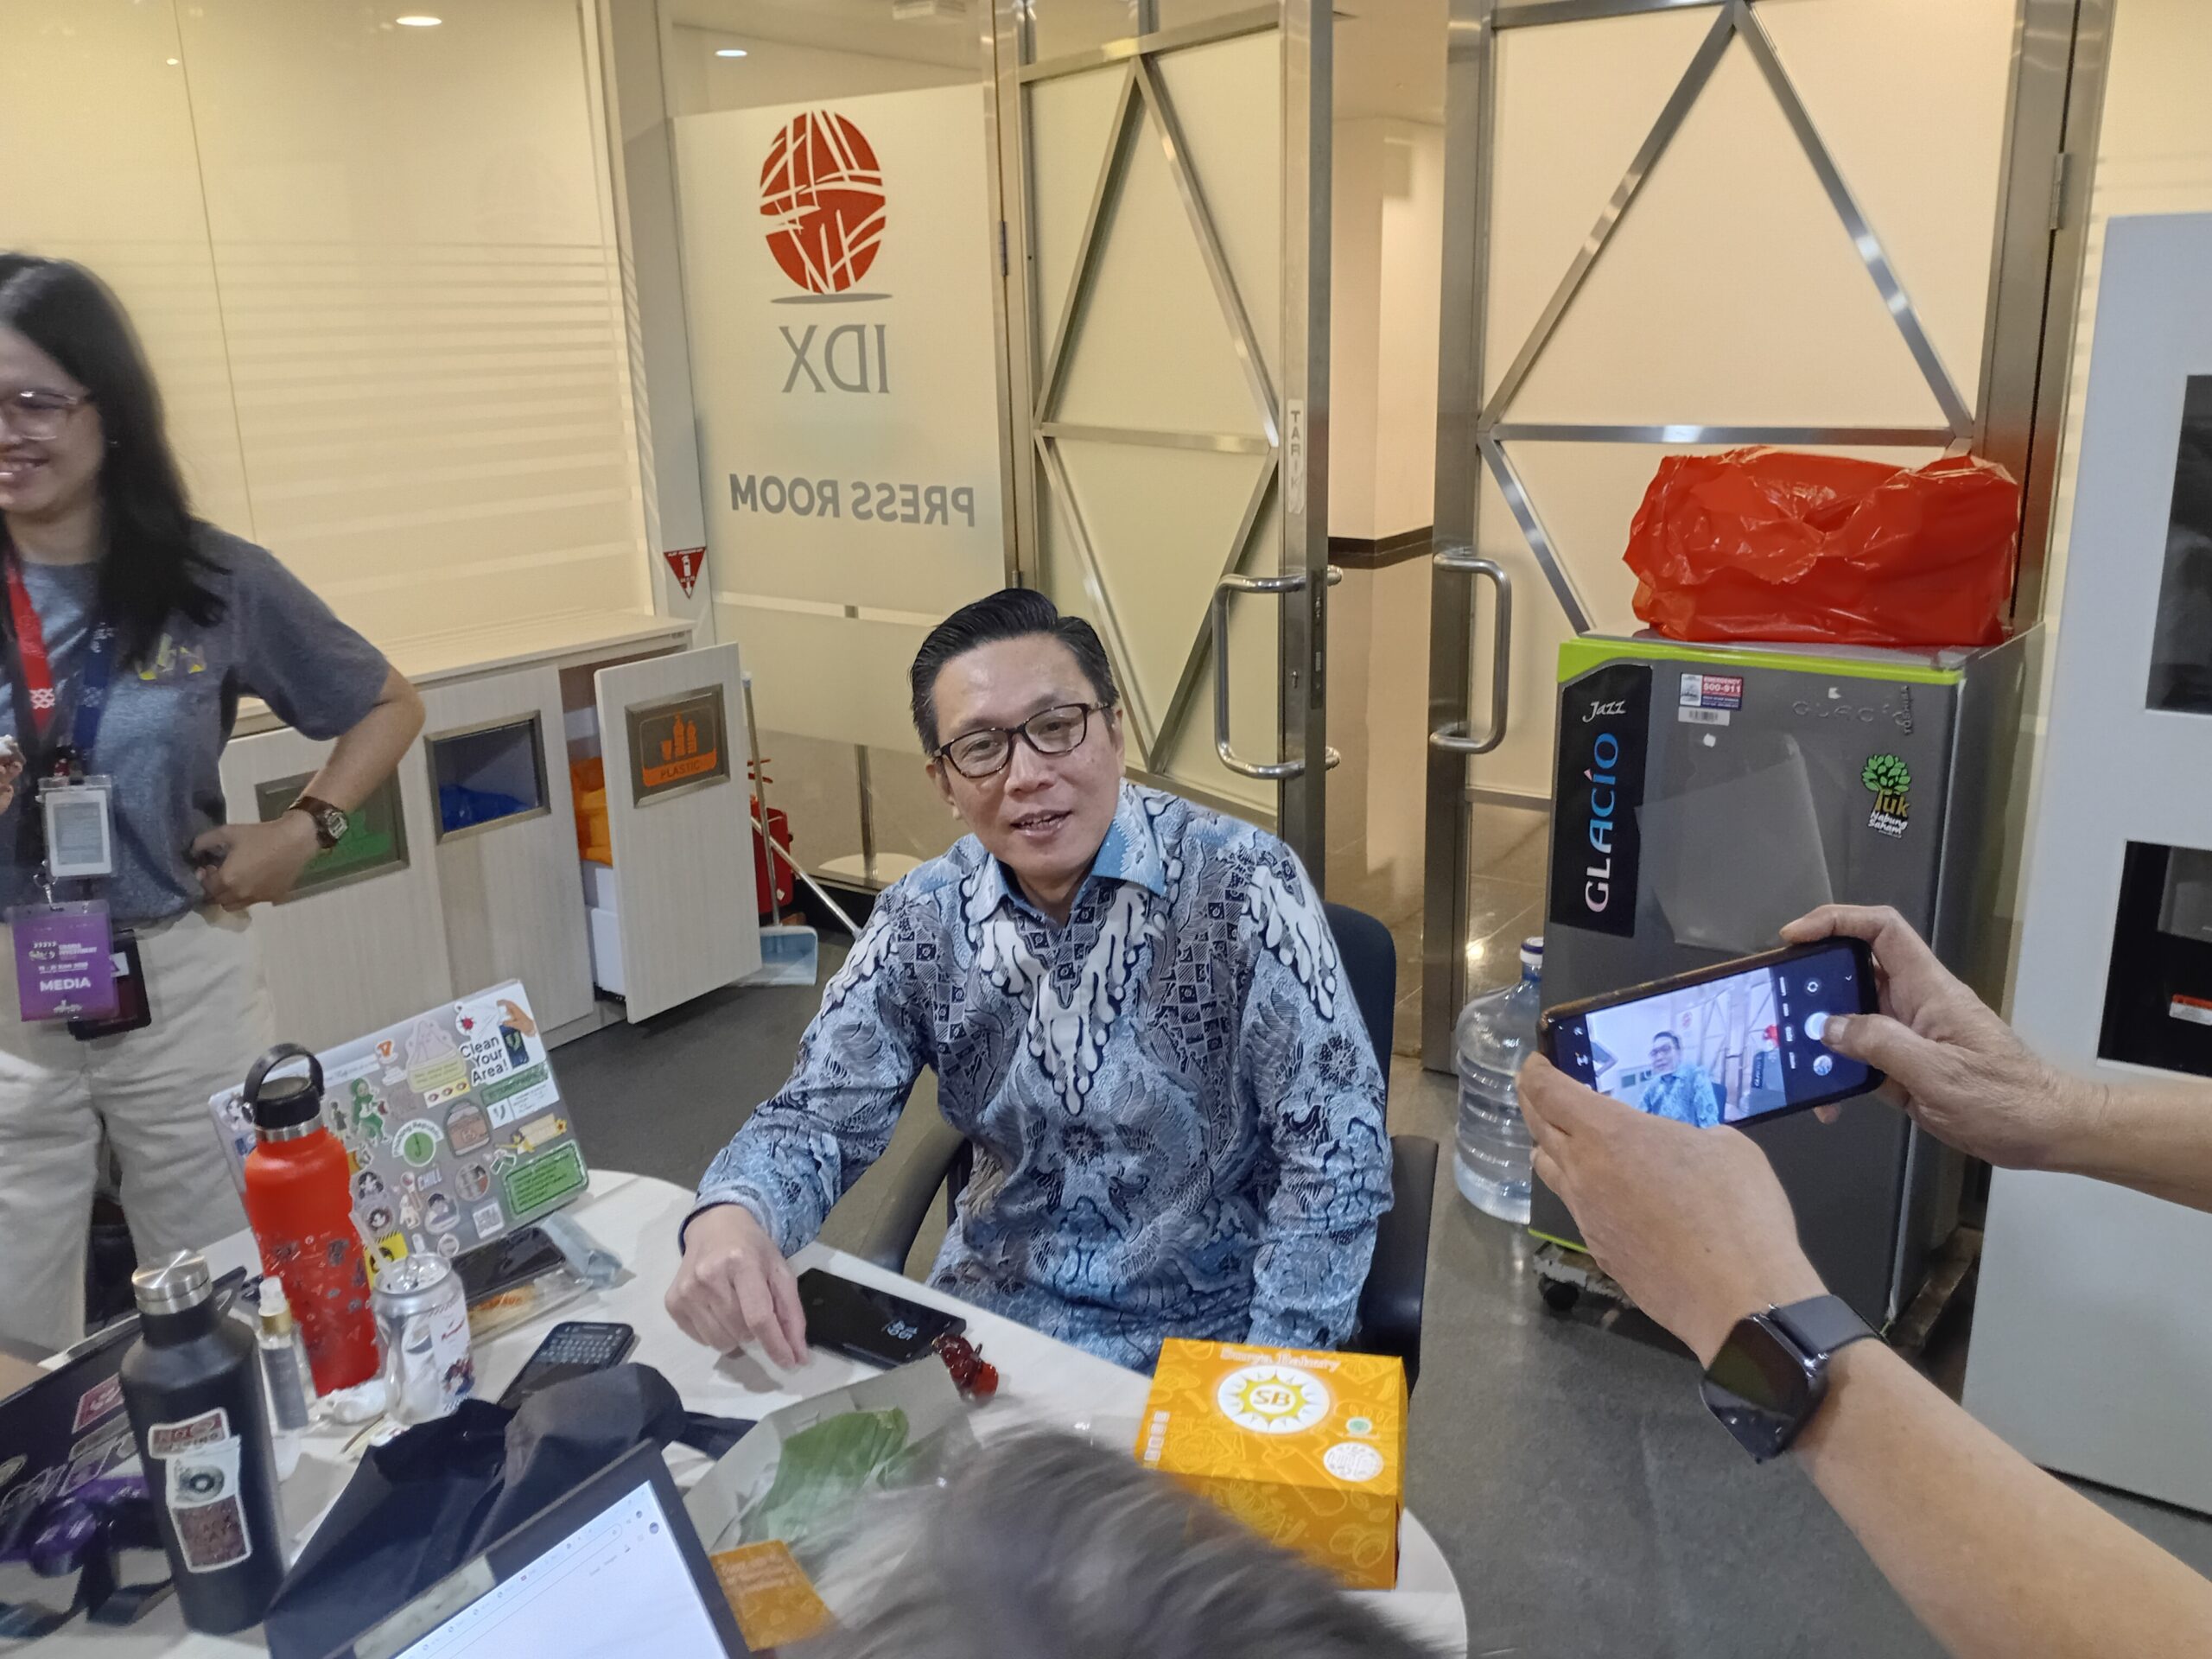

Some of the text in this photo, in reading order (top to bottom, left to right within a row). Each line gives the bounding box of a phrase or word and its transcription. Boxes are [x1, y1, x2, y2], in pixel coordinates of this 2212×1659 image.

[1582, 700, 1625, 723] Jazz
[659, 760, 702, 779] PLASTIC
[1867, 818, 1903, 836] Saham
[1870, 810, 1908, 830] Nabung
[39, 976, 92, 992] MEDIA
[460, 1036, 500, 1058] Clean
[474, 1048, 503, 1069] Your
[471, 1058, 509, 1084] Area!
[1255, 1389, 1291, 1408] SB
